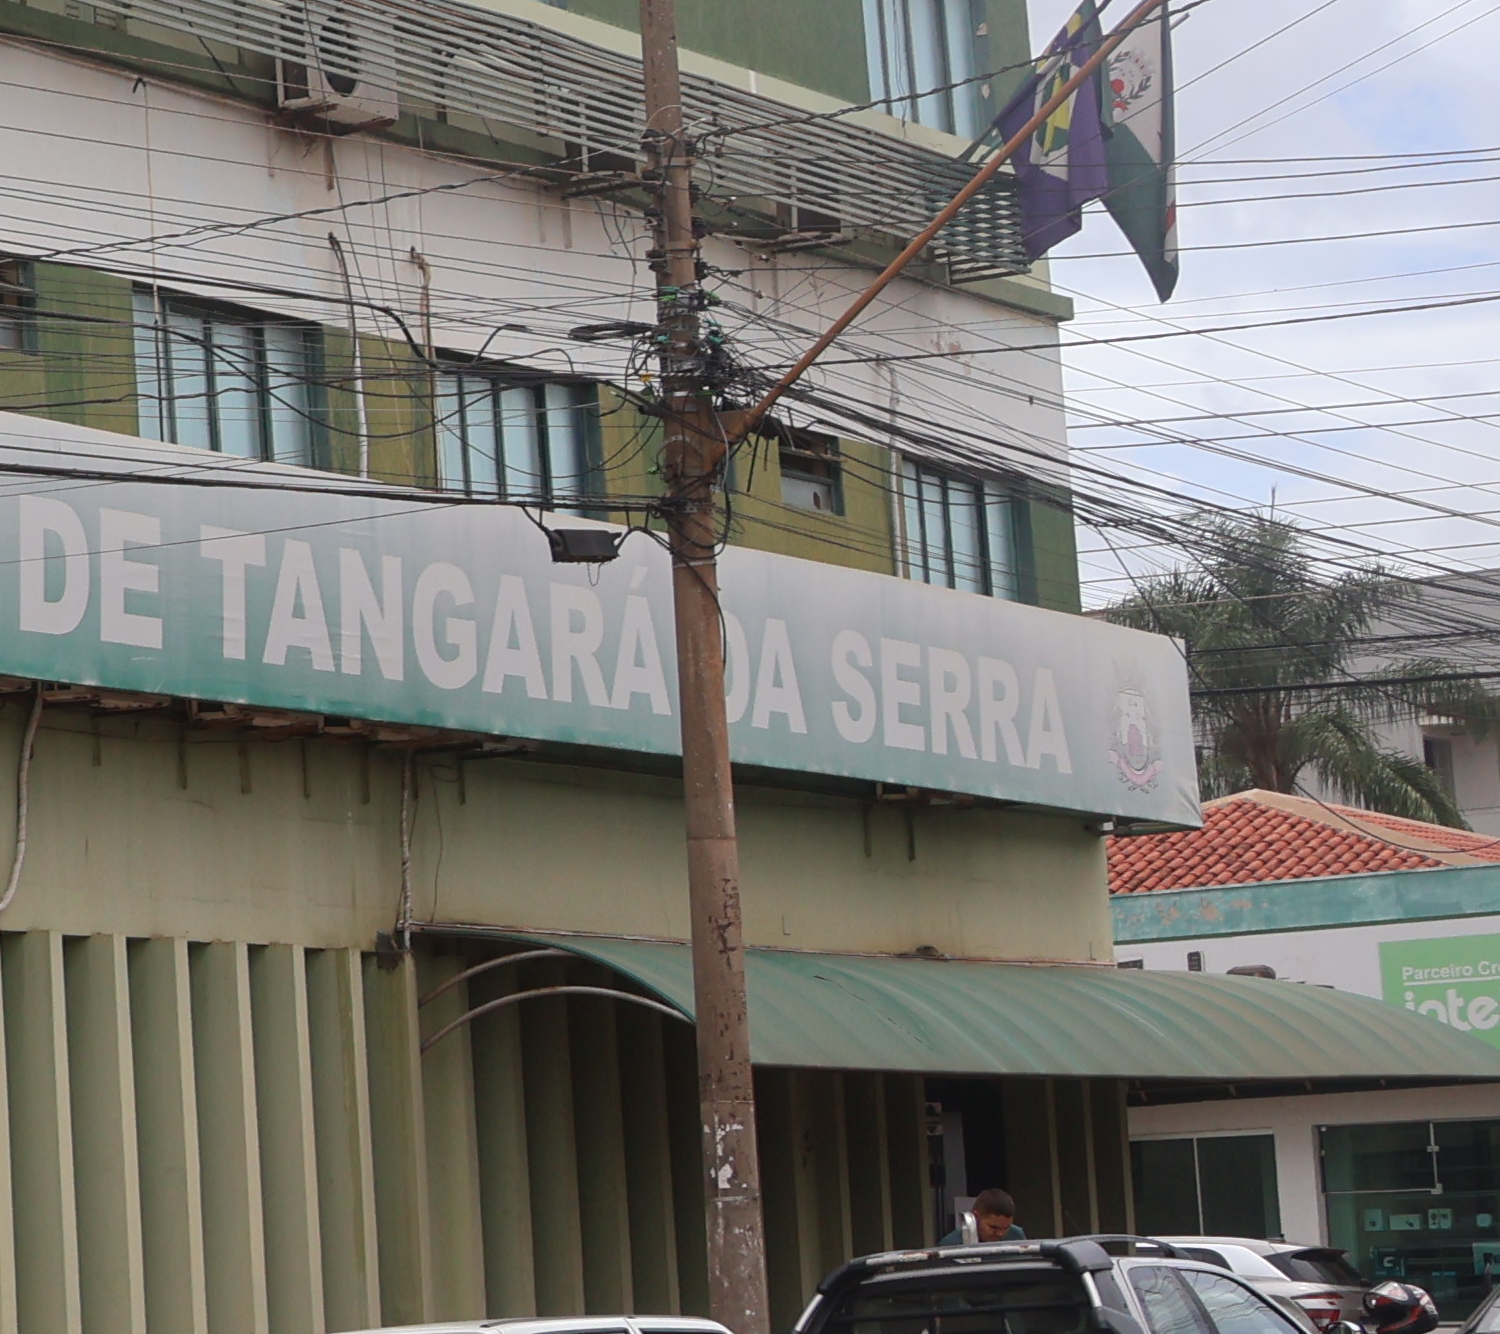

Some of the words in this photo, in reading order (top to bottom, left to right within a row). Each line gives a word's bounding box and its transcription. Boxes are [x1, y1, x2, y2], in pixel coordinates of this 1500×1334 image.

[17, 494, 164, 650] DE
[198, 526, 673, 716] TANGARÁ
[831, 628, 1074, 774] SERRA
[1402, 963, 1473, 981] Parceiro
